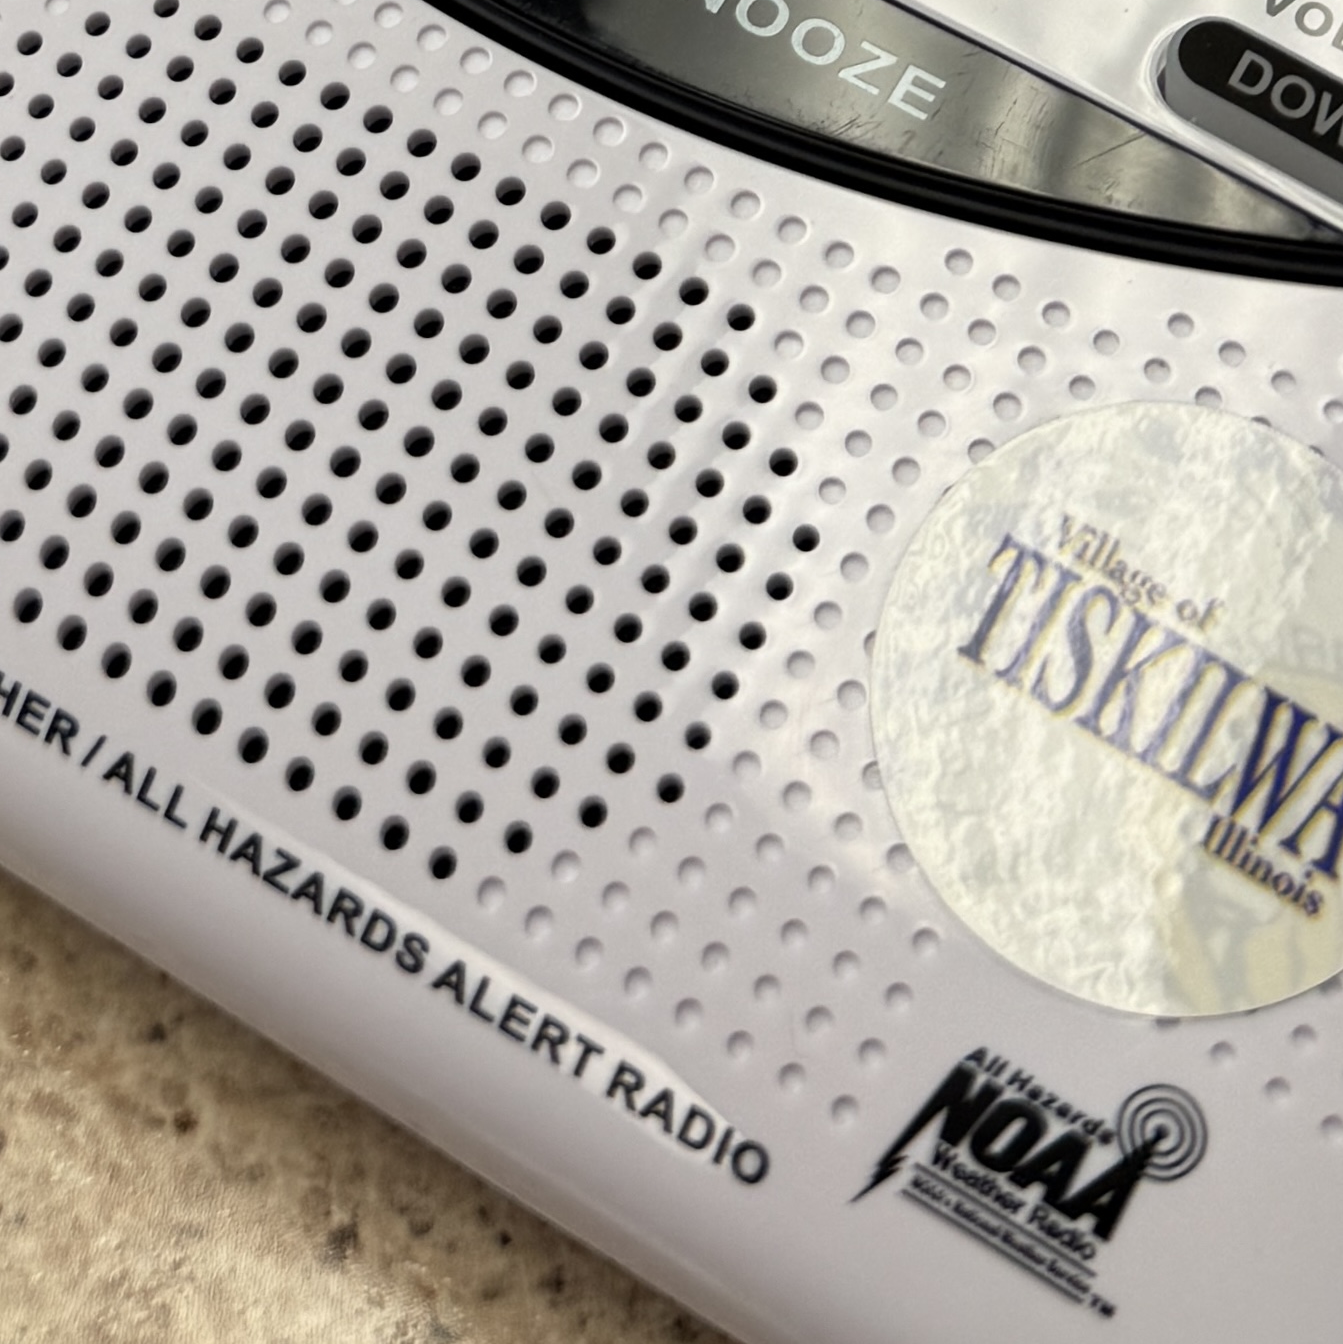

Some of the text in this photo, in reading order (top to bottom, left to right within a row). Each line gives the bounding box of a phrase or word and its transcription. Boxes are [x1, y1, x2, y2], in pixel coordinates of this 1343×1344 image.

[1055, 513, 1226, 633] Village of
[1199, 814, 1327, 922] Illinois
[102, 750, 189, 830] ALL
[198, 806, 432, 977] HAZARDS
[431, 958, 606, 1080] ALERT
[605, 1058, 772, 1186] RADIO
[871, 1058, 1159, 1244] NOAA
[962, 1045, 1118, 1147] All Hazards
